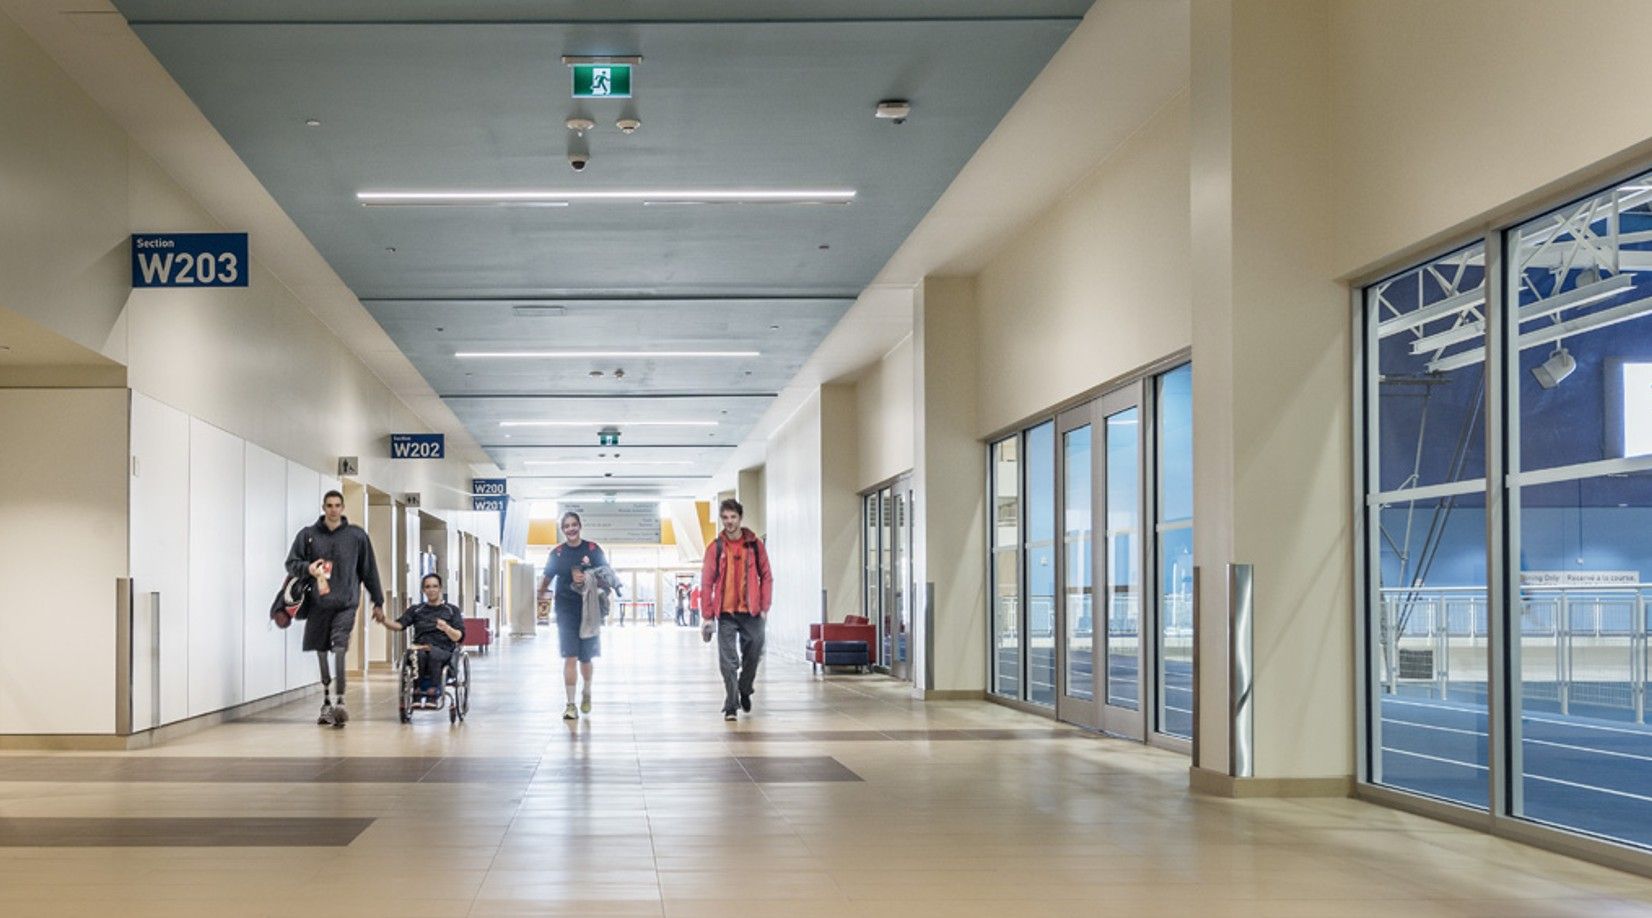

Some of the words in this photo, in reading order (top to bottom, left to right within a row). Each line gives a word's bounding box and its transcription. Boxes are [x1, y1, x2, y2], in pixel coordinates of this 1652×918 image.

[137, 237, 175, 248] Section
[138, 252, 239, 284] W203
[393, 442, 440, 457] W202
[474, 483, 504, 494] W200
[474, 500, 504, 511] W201
